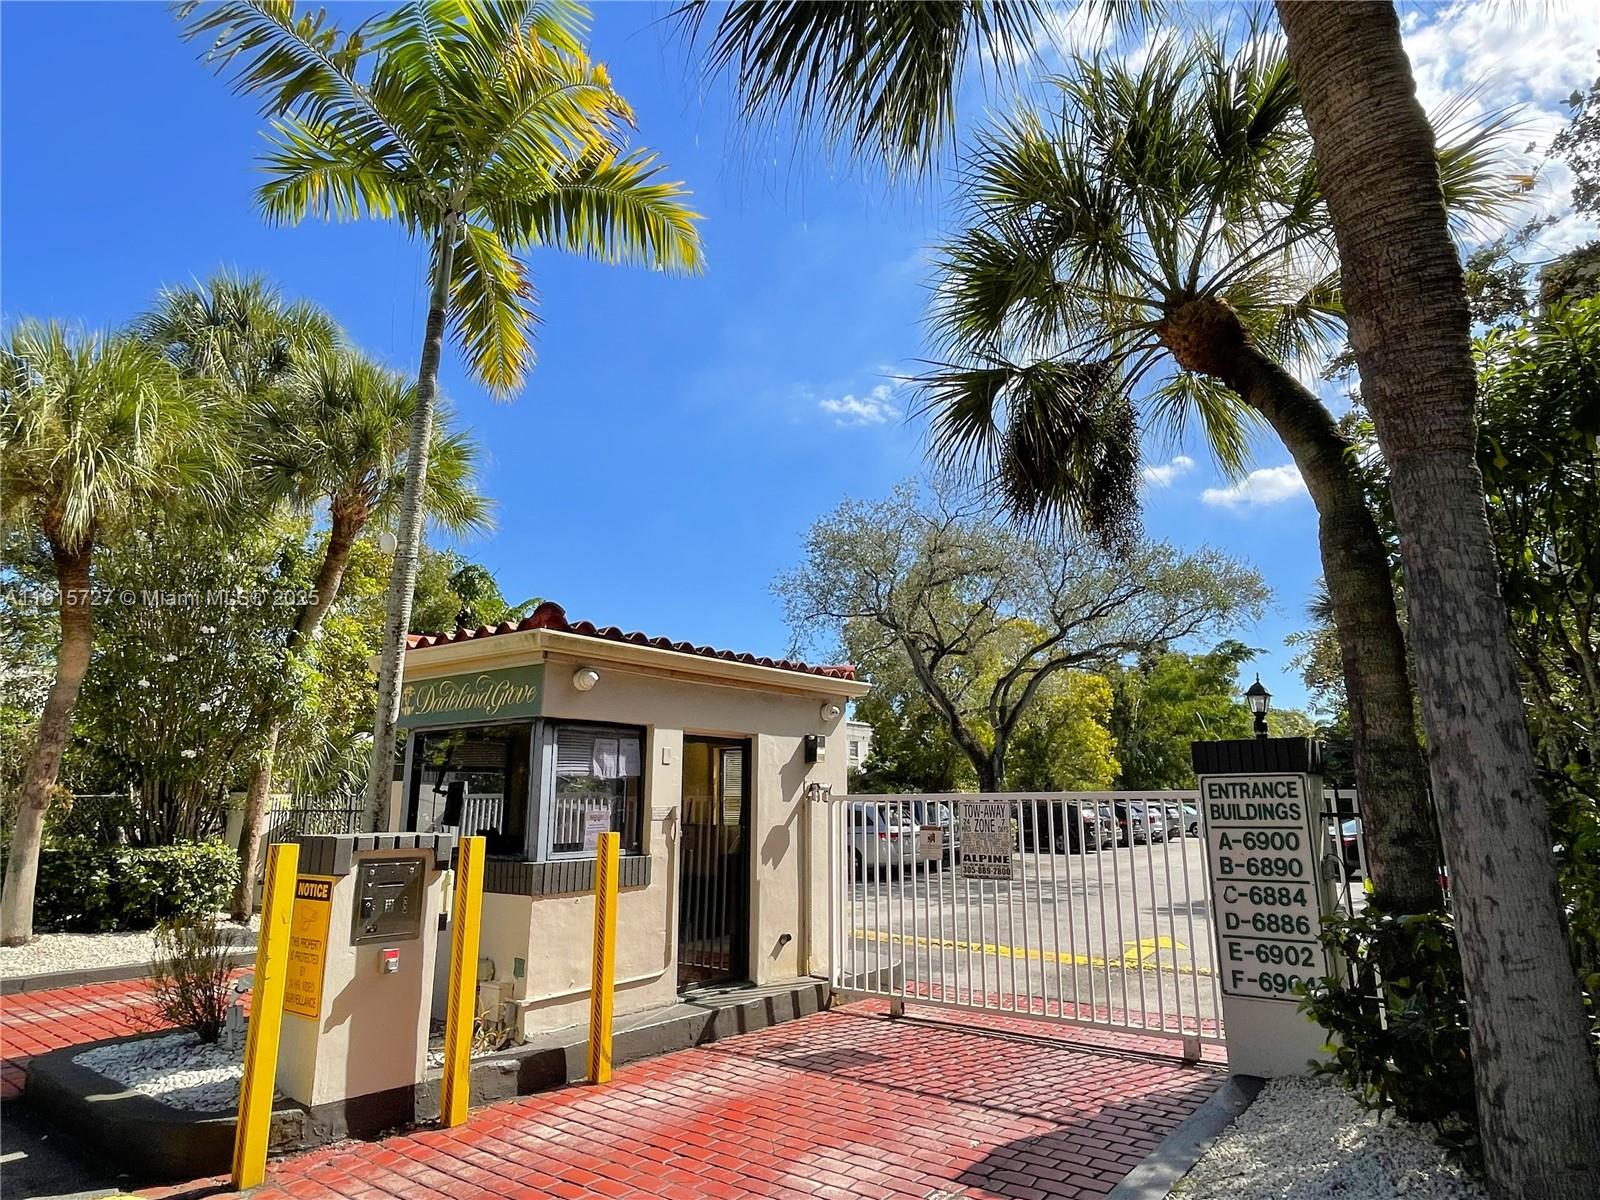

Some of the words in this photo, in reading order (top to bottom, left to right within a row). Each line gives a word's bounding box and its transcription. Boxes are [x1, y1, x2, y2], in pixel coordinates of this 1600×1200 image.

[415, 674, 495, 715] Dadeland
[486, 679, 538, 716] Grove
[1208, 781, 1299, 800] ENTRANCE
[964, 804, 1006, 818] TOW-AWAY
[1210, 802, 1301, 821] BUILDINGS
[974, 819, 995, 832] ZONE
[1218, 831, 1300, 851] A-6900
[963, 853, 1010, 864] ALPINE
[1219, 856, 1304, 878] B-6890
[297, 882, 329, 898] NOTICE
[1223, 885, 1308, 908] C-6884
[1225, 912, 1311, 935] D-6886
[1228, 941, 1316, 967] E-6902
